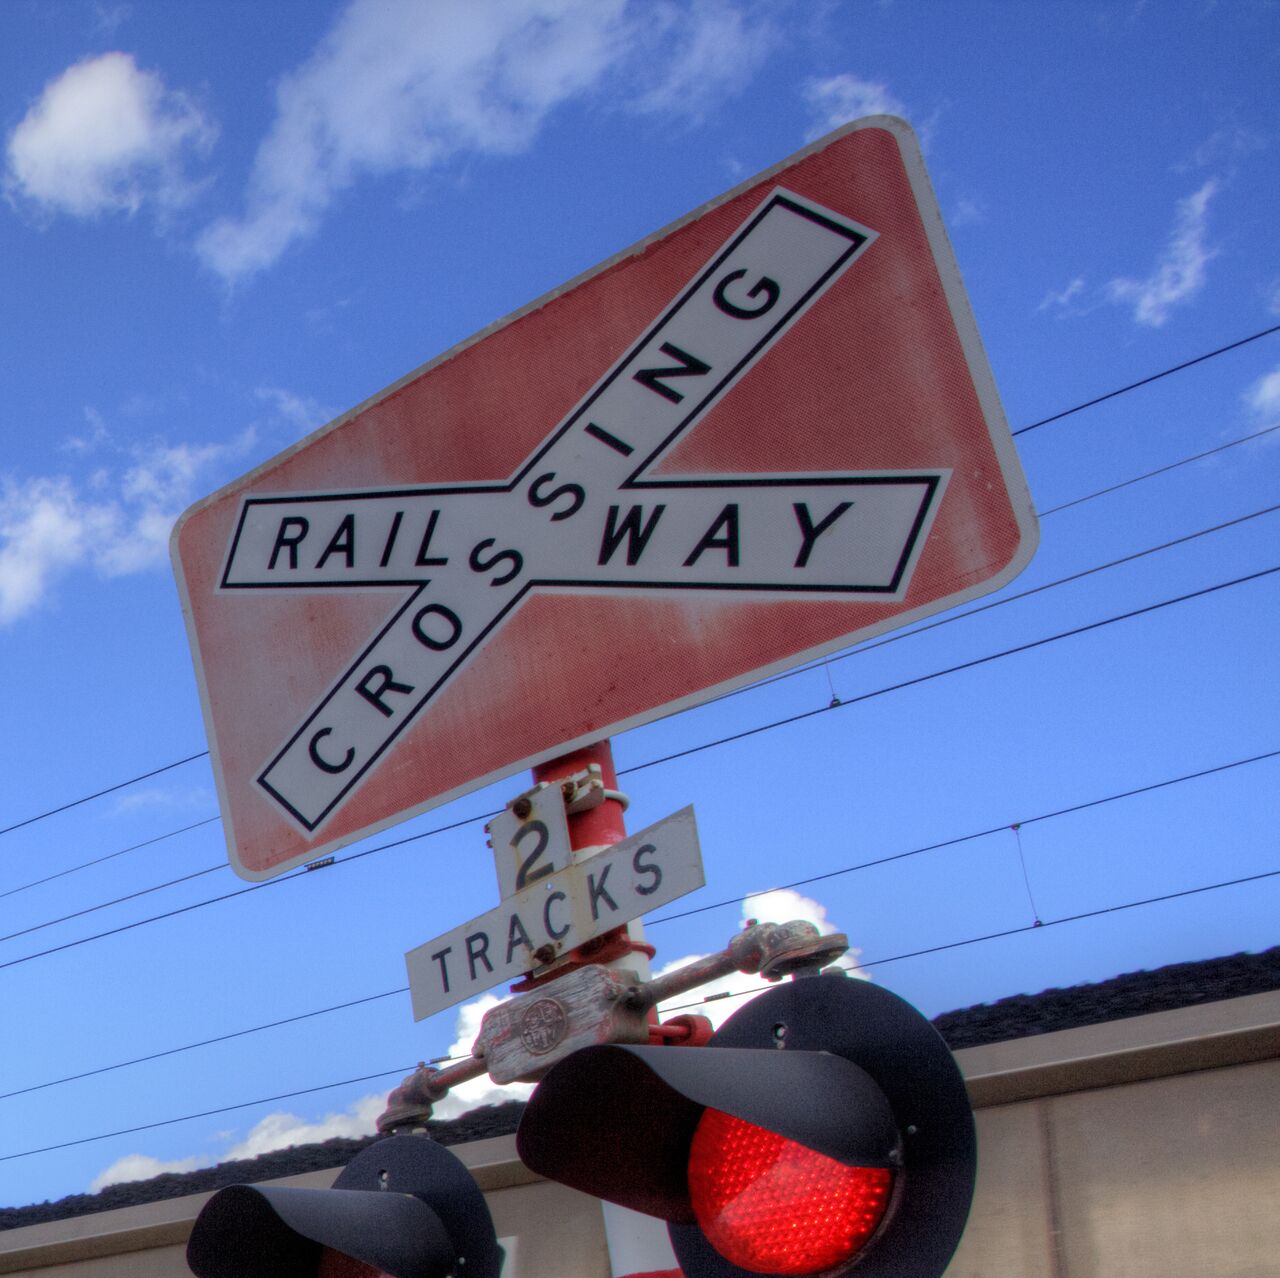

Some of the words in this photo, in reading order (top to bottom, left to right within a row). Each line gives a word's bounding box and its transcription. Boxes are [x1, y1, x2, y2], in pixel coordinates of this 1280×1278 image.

[268, 509, 450, 571] RAIL
[598, 502, 855, 568] WAY
[308, 268, 781, 775] CROSSING
[509, 820, 551, 890] 2
[431, 844, 664, 993] TRACKS
